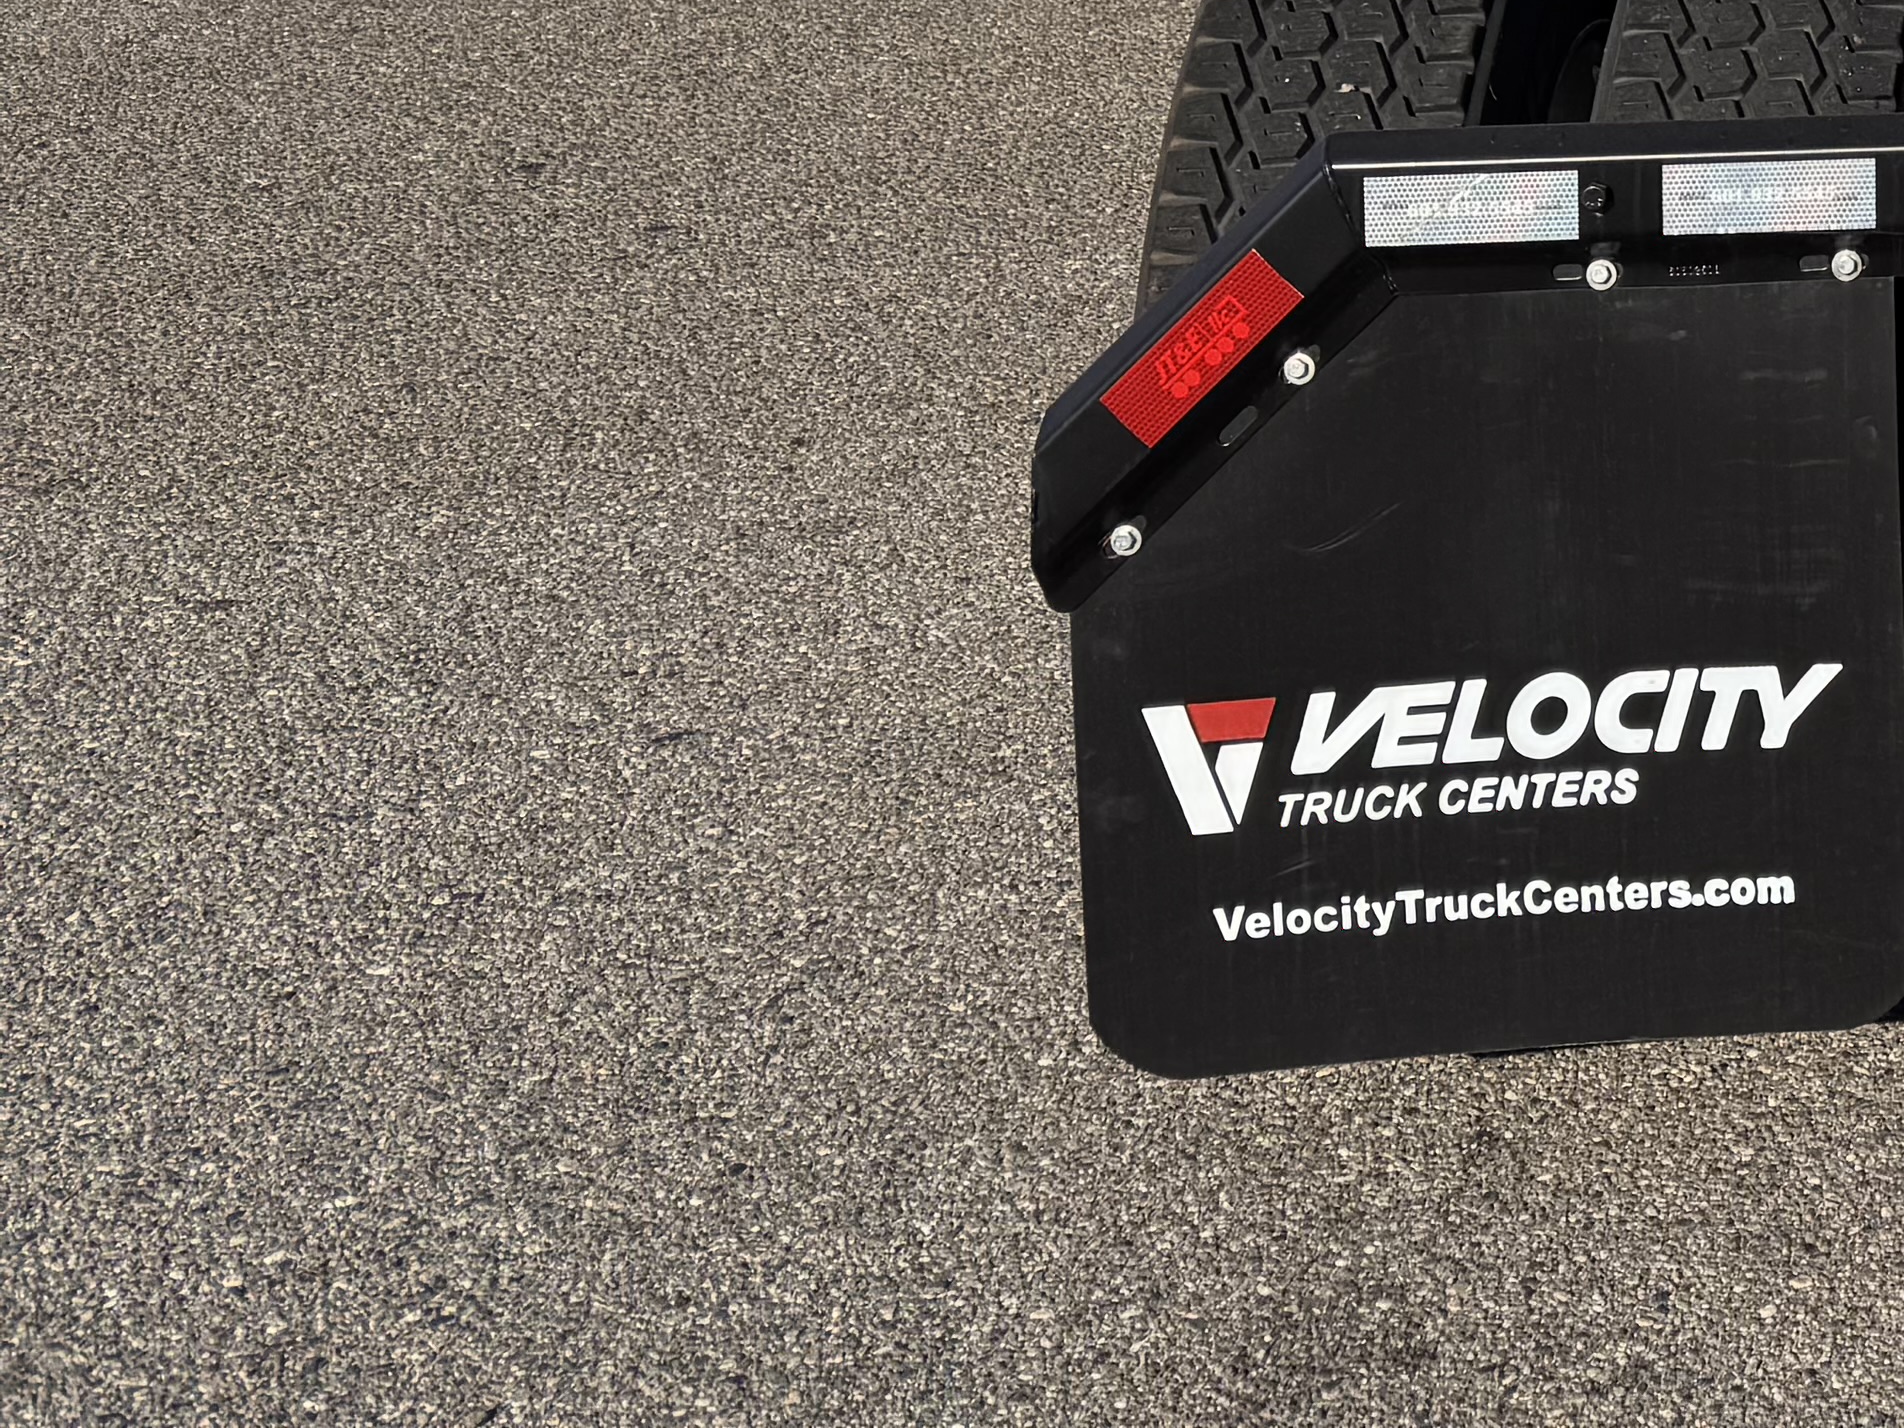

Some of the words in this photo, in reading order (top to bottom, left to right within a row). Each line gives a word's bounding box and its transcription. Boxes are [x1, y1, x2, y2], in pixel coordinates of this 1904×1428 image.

[1290, 661, 1844, 777] VELOCITY
[1276, 780, 1424, 829] TRUCK
[1437, 767, 1640, 816] CENTERS
[1212, 870, 1797, 943] VelocityTruckCenters.com
